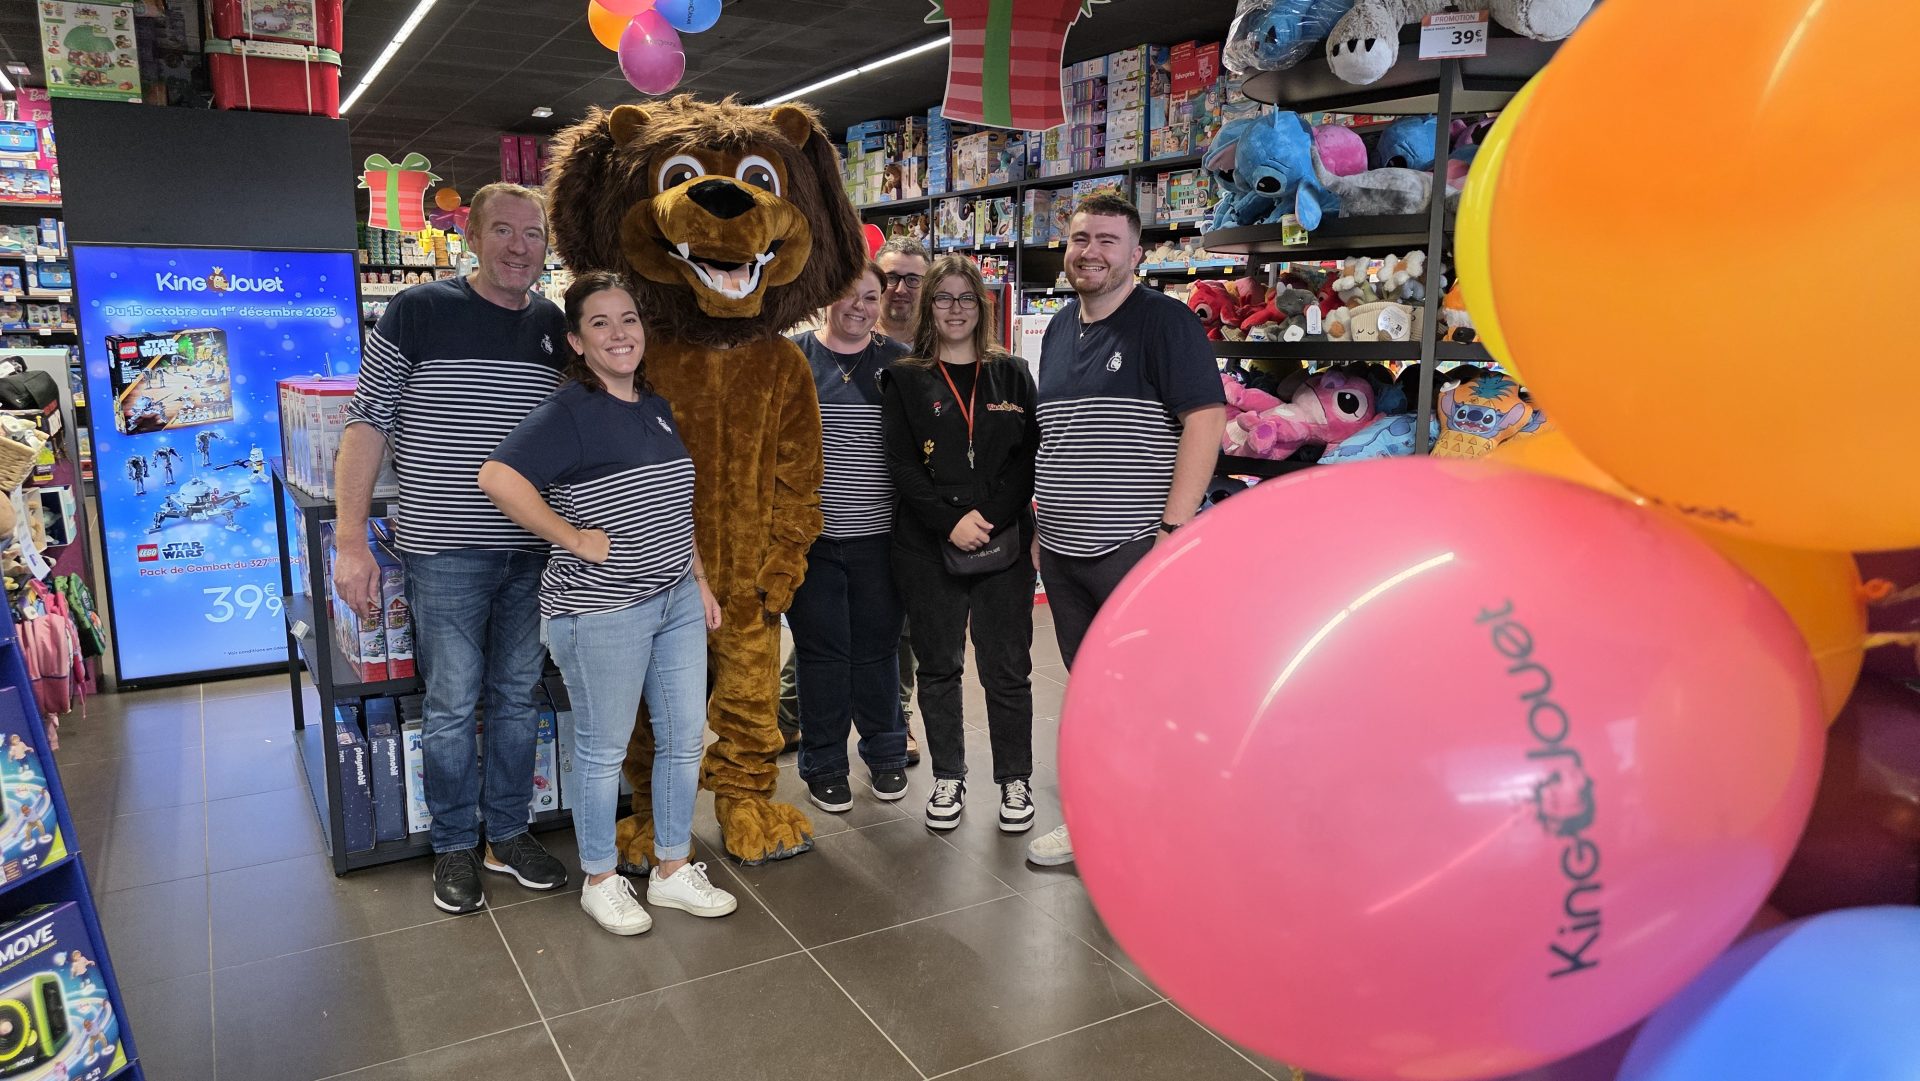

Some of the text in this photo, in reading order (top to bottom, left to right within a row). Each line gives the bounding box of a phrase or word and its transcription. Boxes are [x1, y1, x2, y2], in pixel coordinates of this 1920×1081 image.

[1435, 14, 1476, 22] PROMOTION
[29, 89, 50, 101] Barb
[33, 109, 52, 121] Barb
[156, 272, 284, 293] King Jouet
[105, 305, 127, 317] Du
[128, 306, 142, 317] 15
[145, 305, 198, 317] octobre
[201, 308, 218, 317] au
[239, 306, 303, 318] décembre
[306, 307, 336, 317] 2025
[162, 542, 205, 551] STAR
[162, 549, 205, 559] WARS
[140, 564, 167, 576] Pack
[170, 565, 184, 574] de
[186, 561, 232, 573] Combat
[234, 560, 248, 569] du
[387, 738, 399, 776] playmobil
[353, 747, 366, 785] playmobil
[1474, 598, 1603, 979] King Jouet
